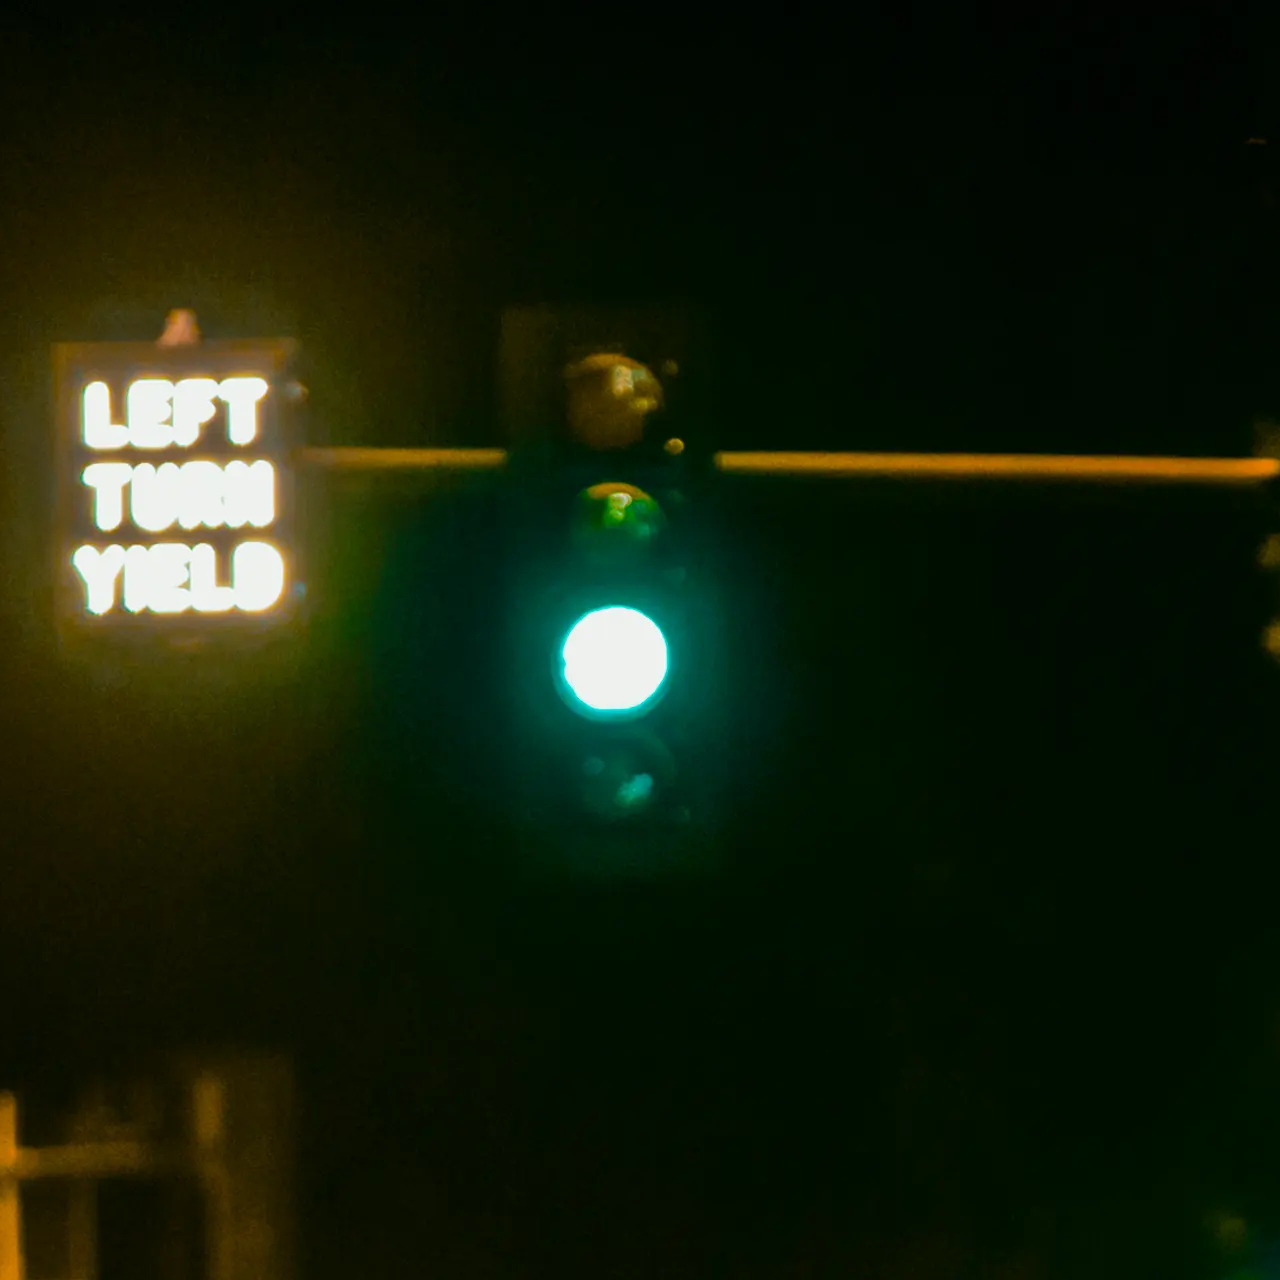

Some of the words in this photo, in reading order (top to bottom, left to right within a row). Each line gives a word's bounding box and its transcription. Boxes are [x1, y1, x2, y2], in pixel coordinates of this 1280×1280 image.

[82, 377, 269, 449] LEFT
[82, 460, 275, 532] TURN
[72, 541, 284, 615] YIELD
